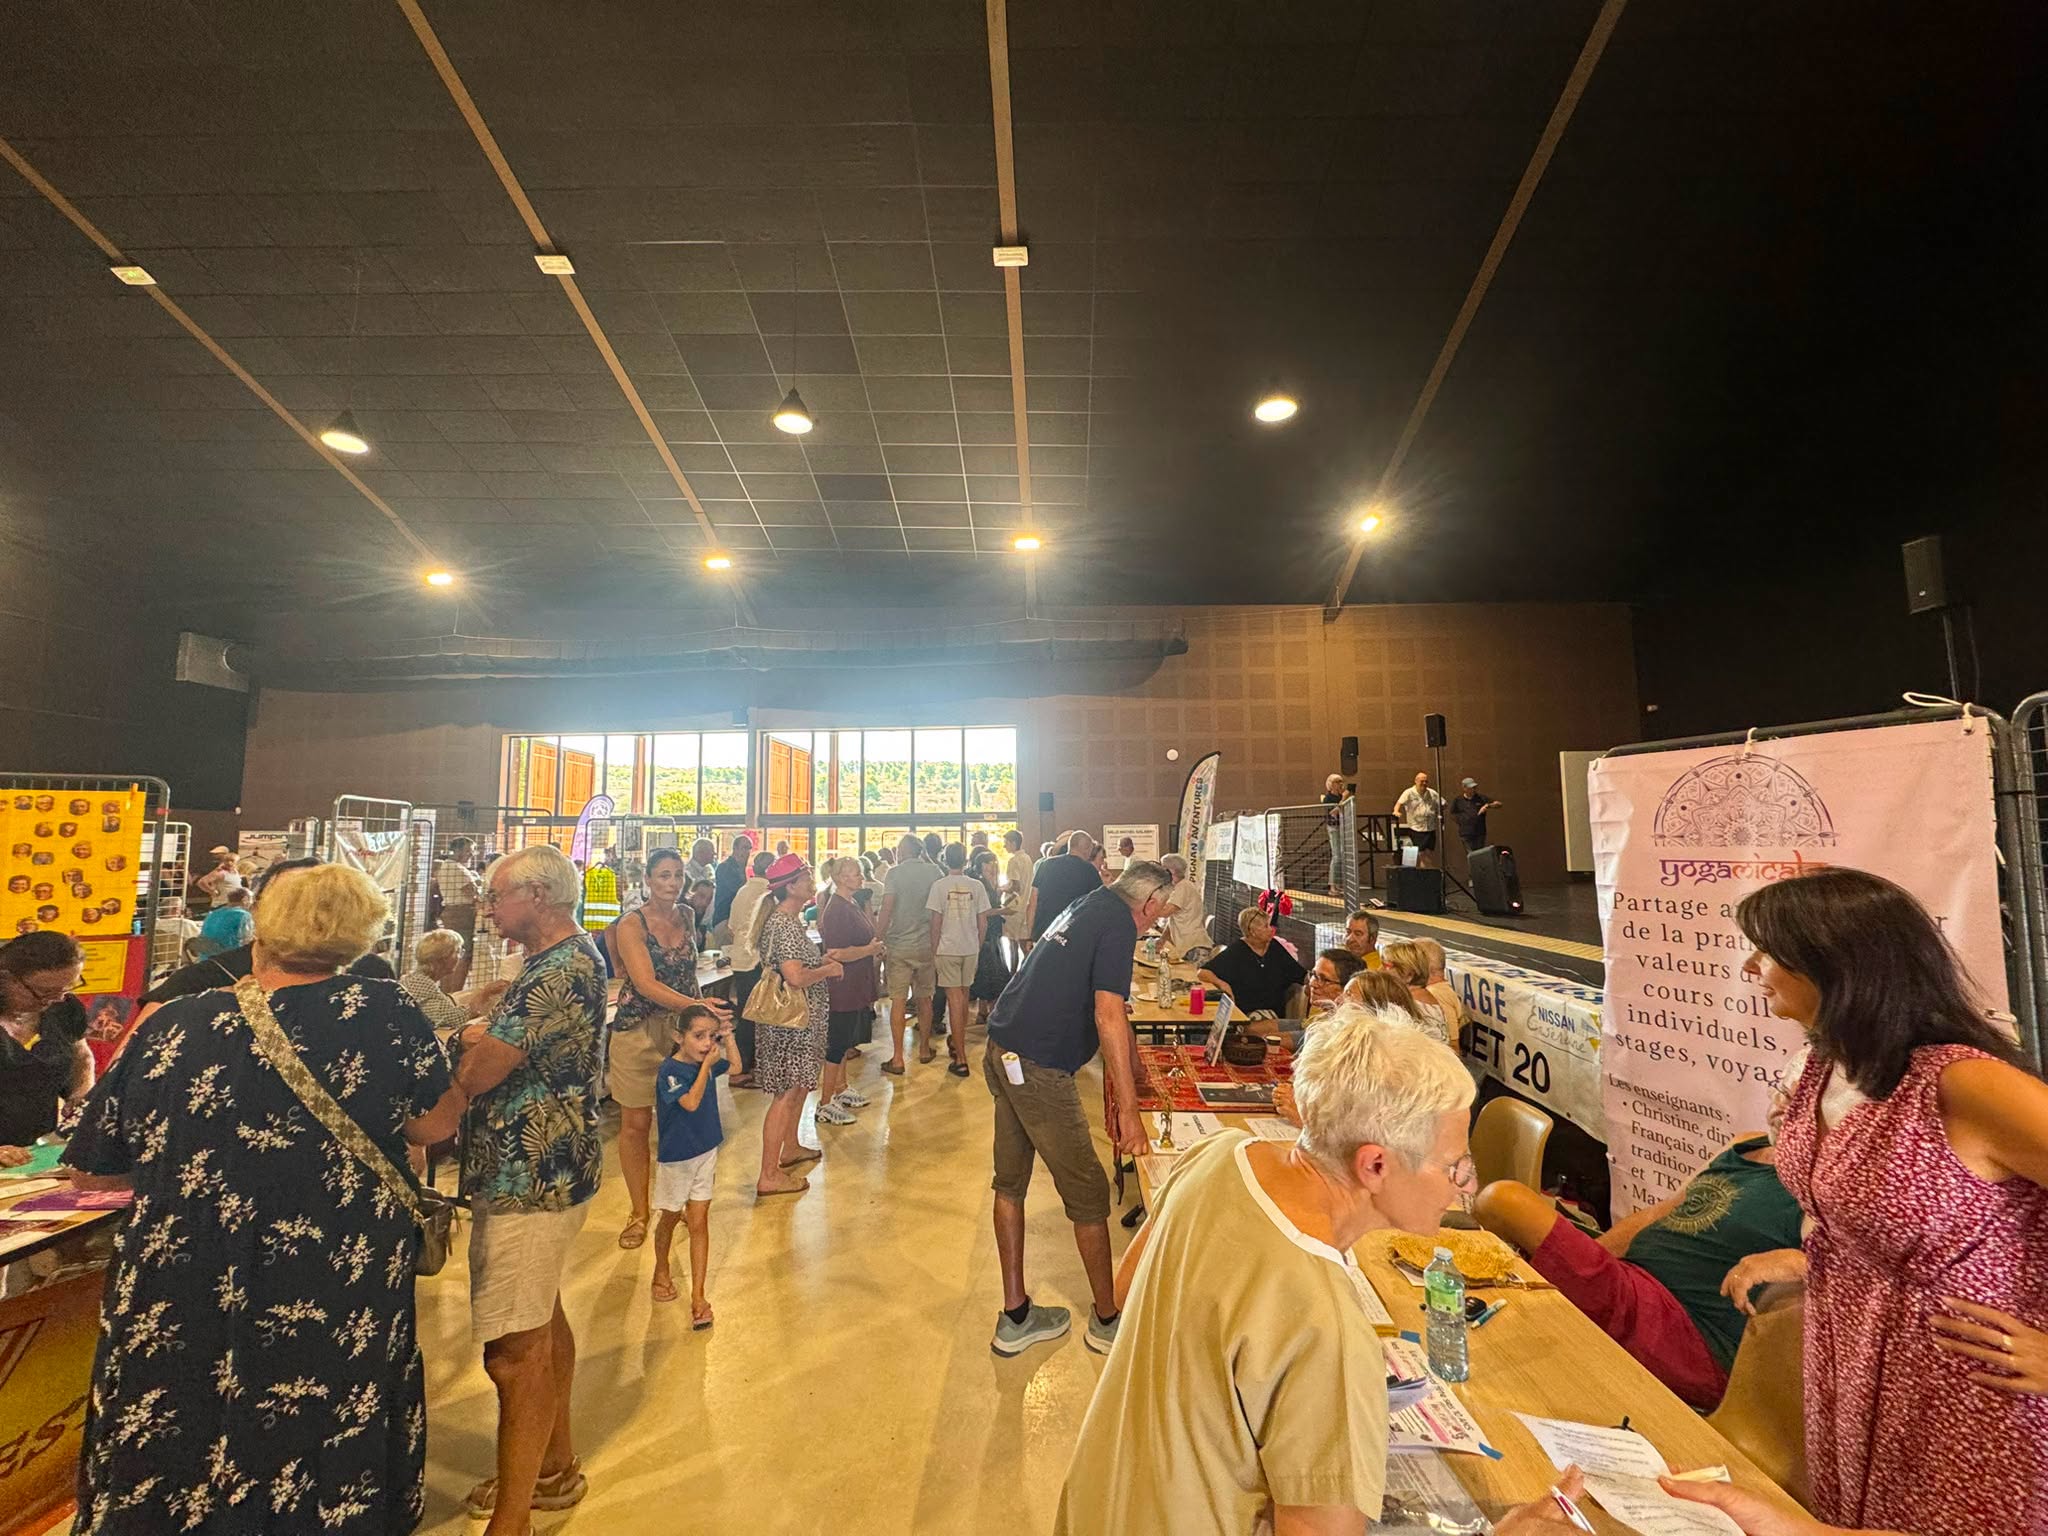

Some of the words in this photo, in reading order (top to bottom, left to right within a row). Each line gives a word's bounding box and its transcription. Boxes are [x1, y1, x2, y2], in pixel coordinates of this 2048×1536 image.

[1191, 777, 1204, 840] AVENTURES
[1188, 842, 1199, 883] PIGNAN
[1659, 850, 1828, 886] yogamical
[1613, 891, 1708, 920] Partage
[1623, 921, 1650, 940] de
[1661, 924, 1684, 943] la
[1636, 953, 1731, 980] valeurs
[1537, 1006, 1575, 1033] NISSAN
[1643, 983, 1713, 1007] cours
[1724, 996, 1790, 1021] coll
[1627, 1003, 1788, 1055] individuels,
[1471, 1021, 1505, 1068] ET
[1512, 1042, 1551, 1093] 20
[1615, 1033, 1696, 1068] stages,
[1608, 1073, 1632, 1092] Les
[1634, 1085, 1723, 1121] enseignants
[1632, 1100, 1703, 1137] Christine,
[1632, 1120, 1695, 1155] Français
[1631, 1166, 1645, 1181] et
